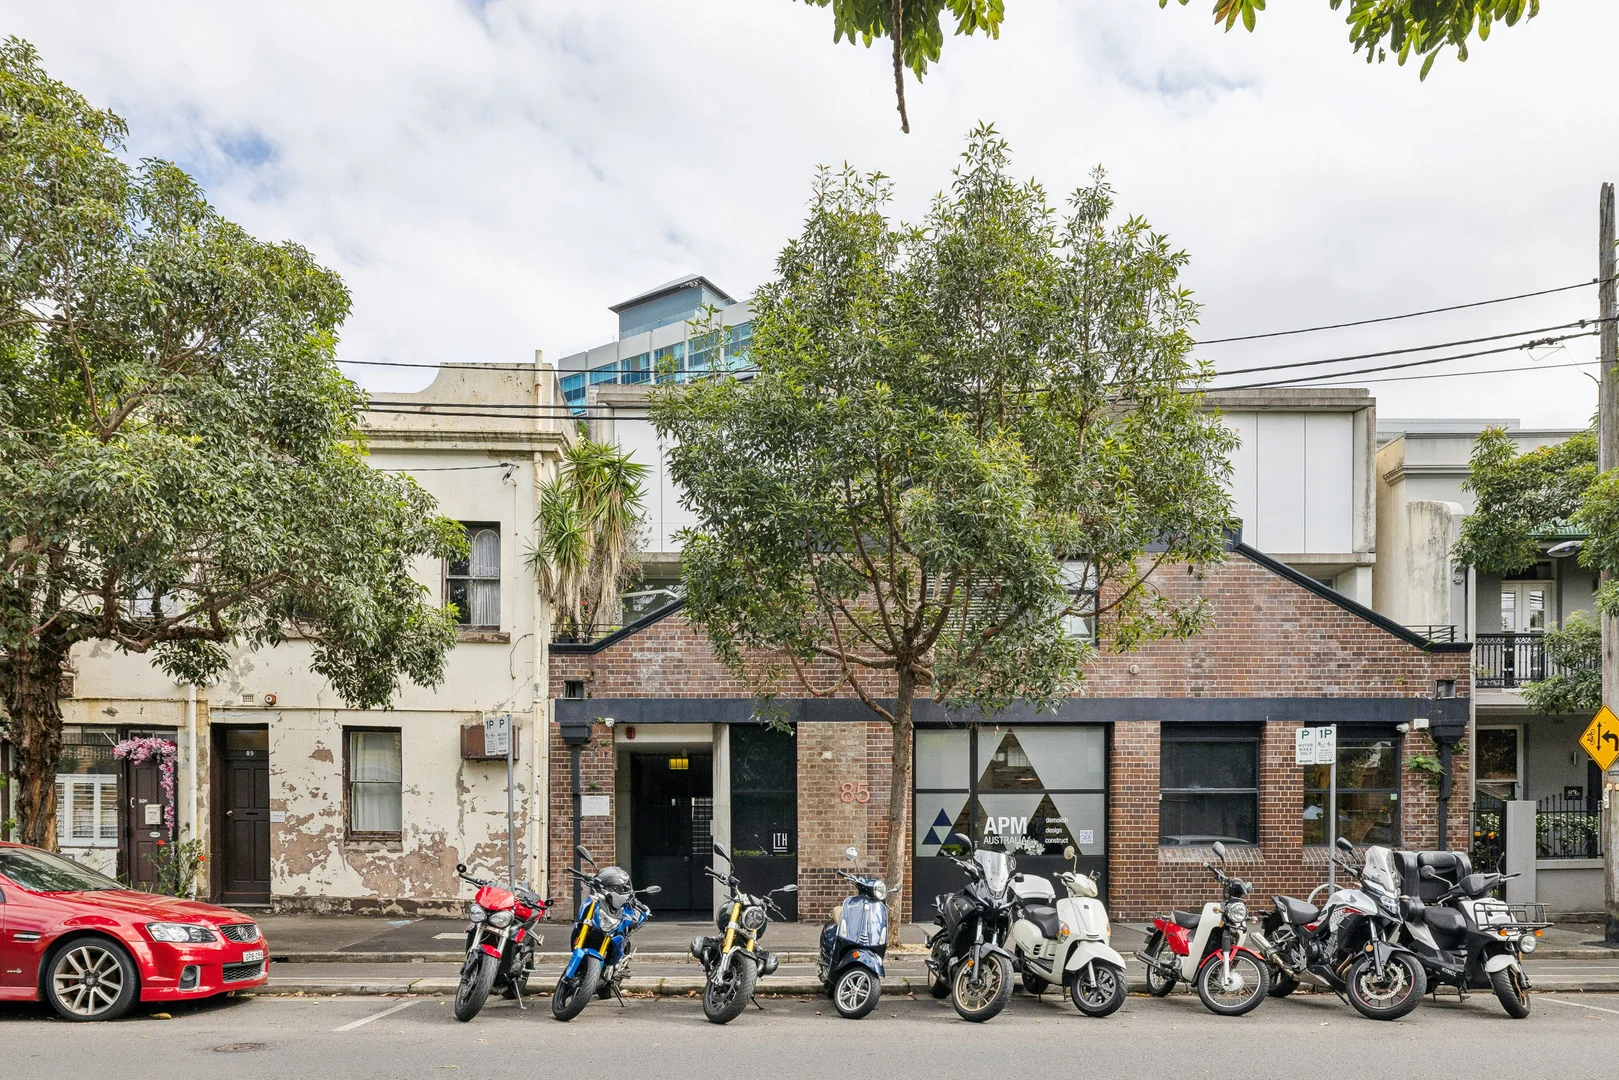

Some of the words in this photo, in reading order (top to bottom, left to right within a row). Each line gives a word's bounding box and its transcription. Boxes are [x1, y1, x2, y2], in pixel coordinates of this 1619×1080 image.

[486, 720, 495, 729] 1P
[499, 719, 505, 728] P
[1301, 730, 1310, 739] P
[1319, 729, 1333, 738] 1P
[840, 782, 870, 803] 85
[983, 816, 1028, 835] APM
[983, 835, 1028, 845] AUSTRALIA
